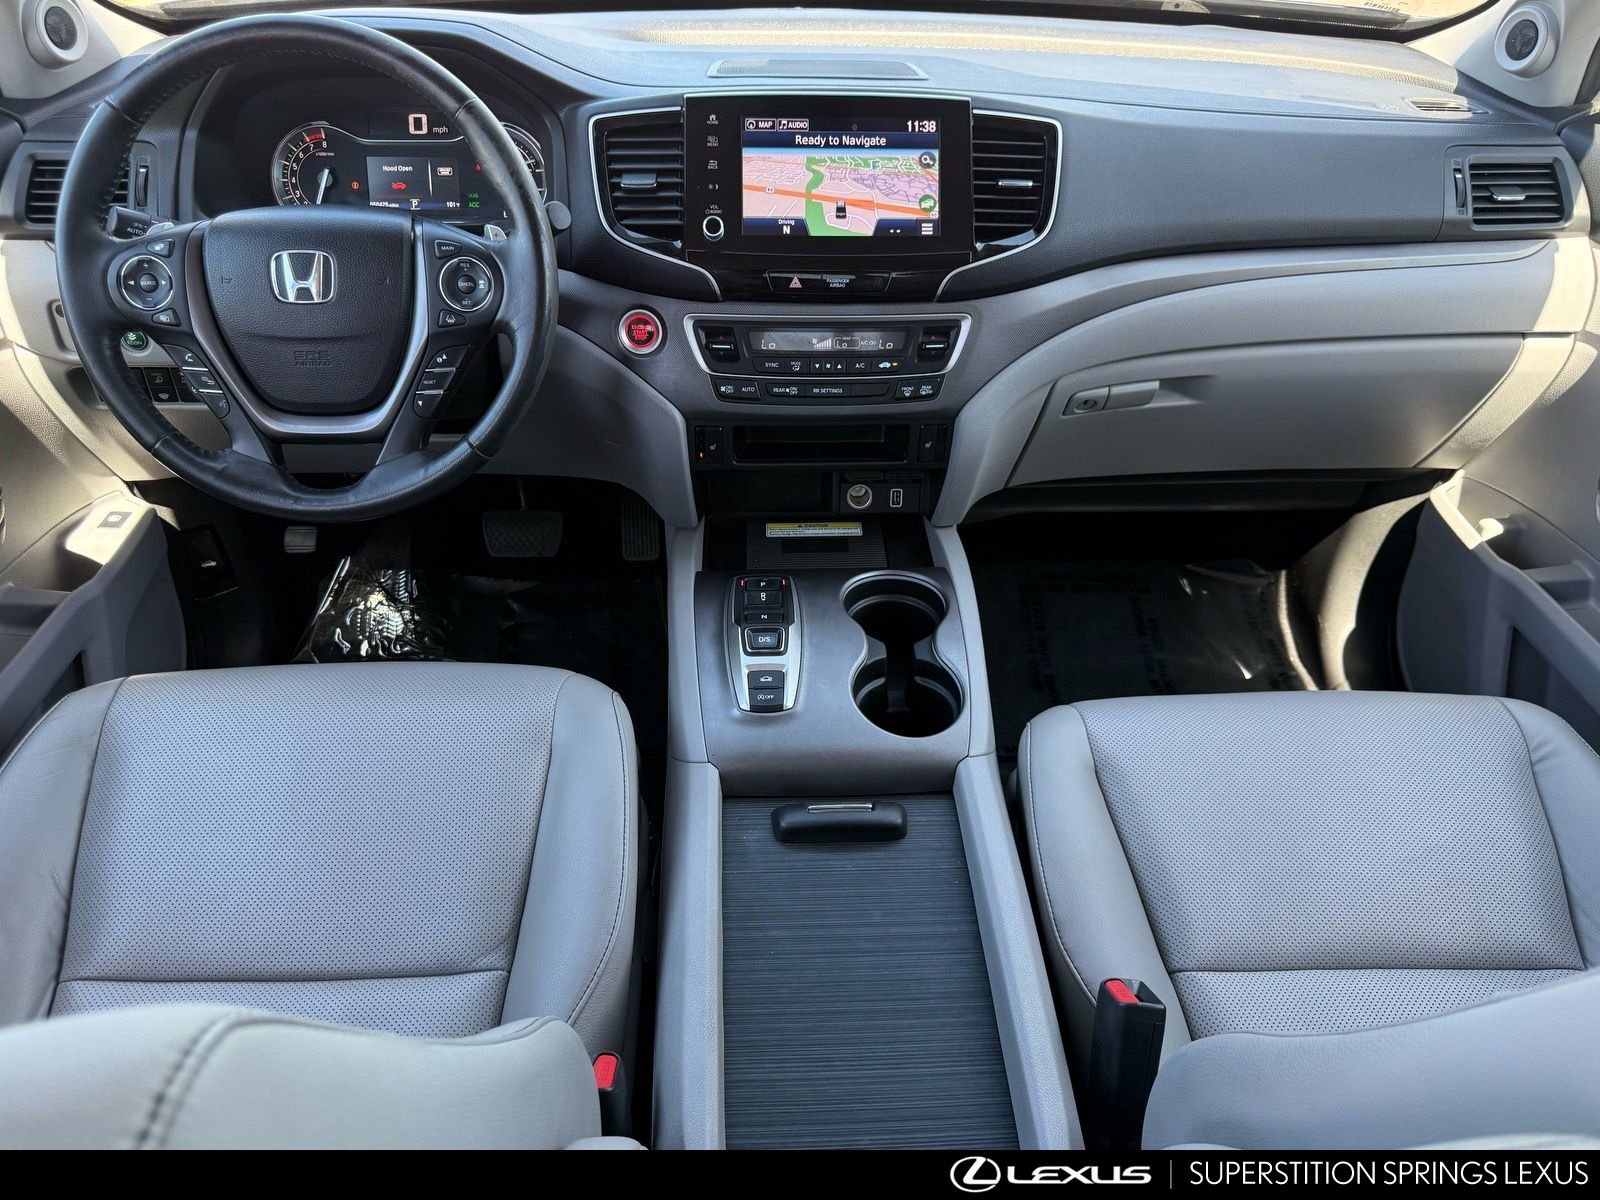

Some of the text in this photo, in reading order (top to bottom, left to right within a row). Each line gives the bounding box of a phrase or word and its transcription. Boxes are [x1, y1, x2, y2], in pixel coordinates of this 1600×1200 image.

[432, 126, 448, 134] mph
[906, 120, 936, 132] 11:38
[795, 134, 886, 147] Ready to Navigate
[783, 226, 790, 234] N
